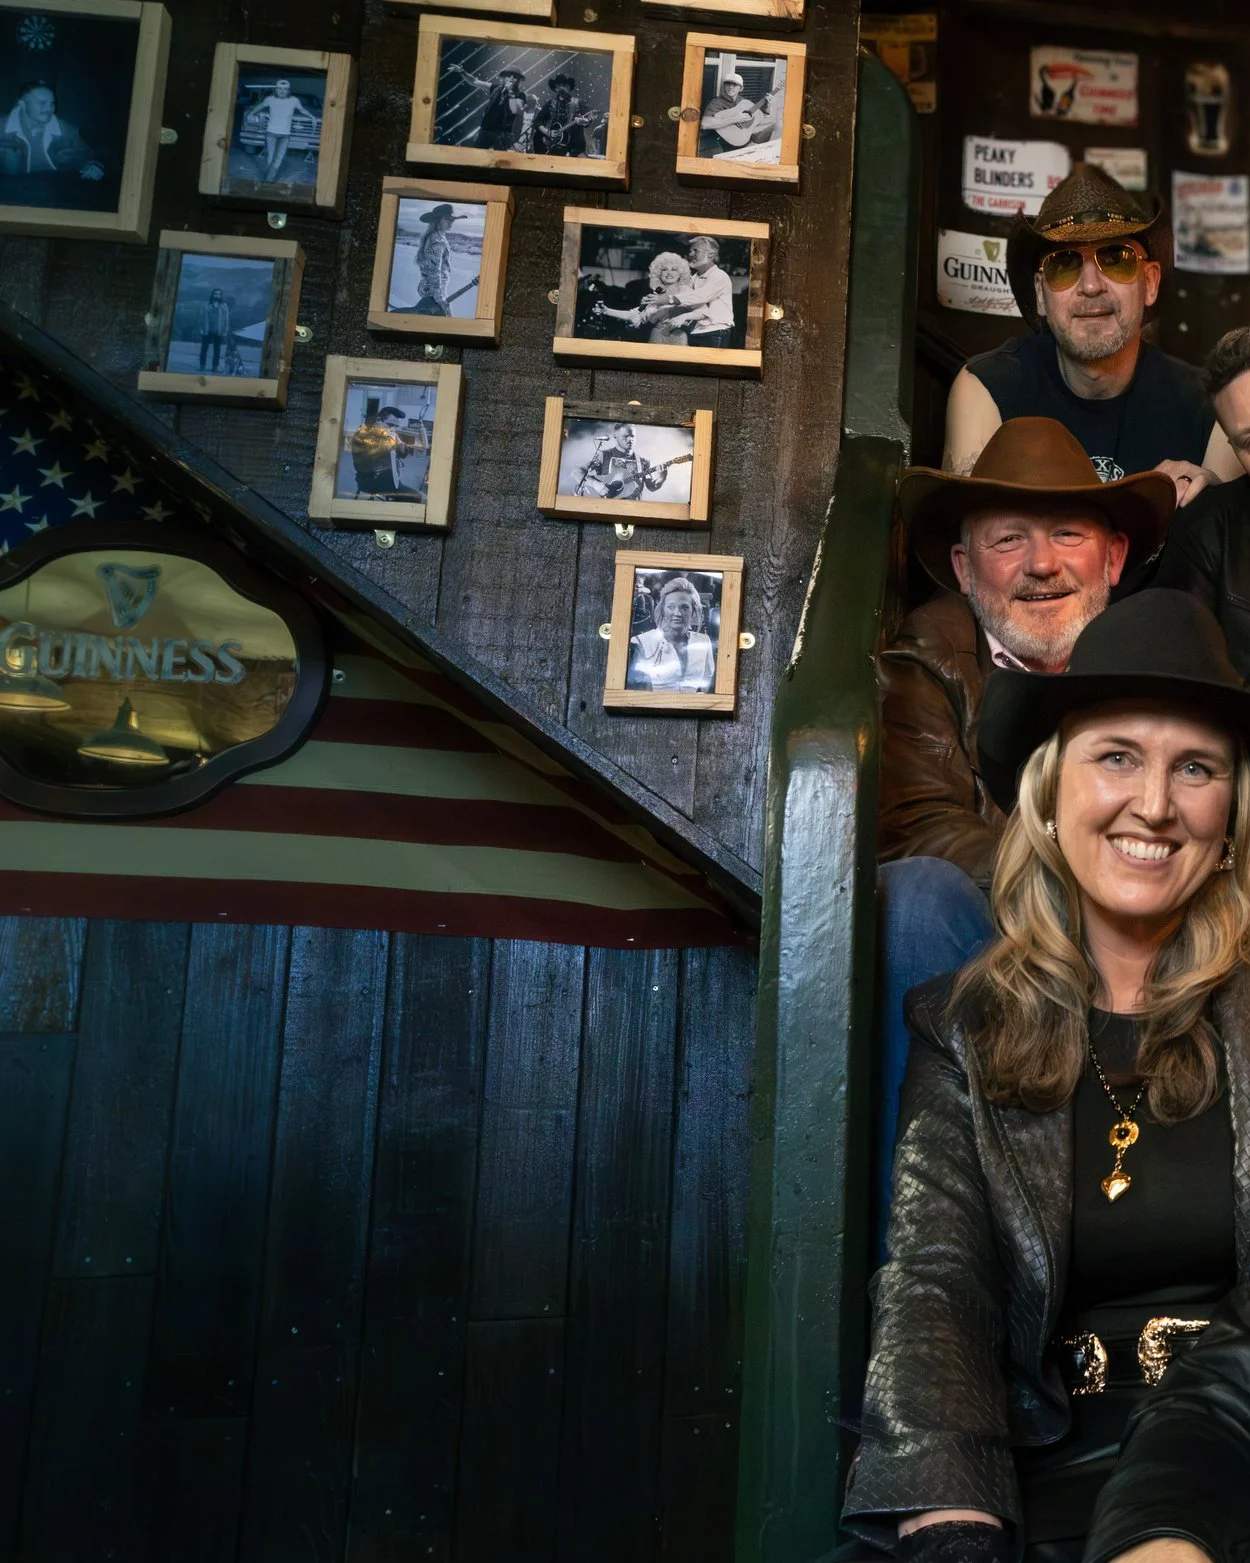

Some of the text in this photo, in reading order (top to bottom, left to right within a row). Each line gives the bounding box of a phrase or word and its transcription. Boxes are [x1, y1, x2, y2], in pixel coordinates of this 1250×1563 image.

[974, 143, 1016, 165] PEAKY
[974, 167, 1035, 189] BLINDERS
[944, 256, 1008, 286] GUINN
[970, 284, 1012, 294] DRAUGH
[0, 621, 247, 685] GUINNESS
